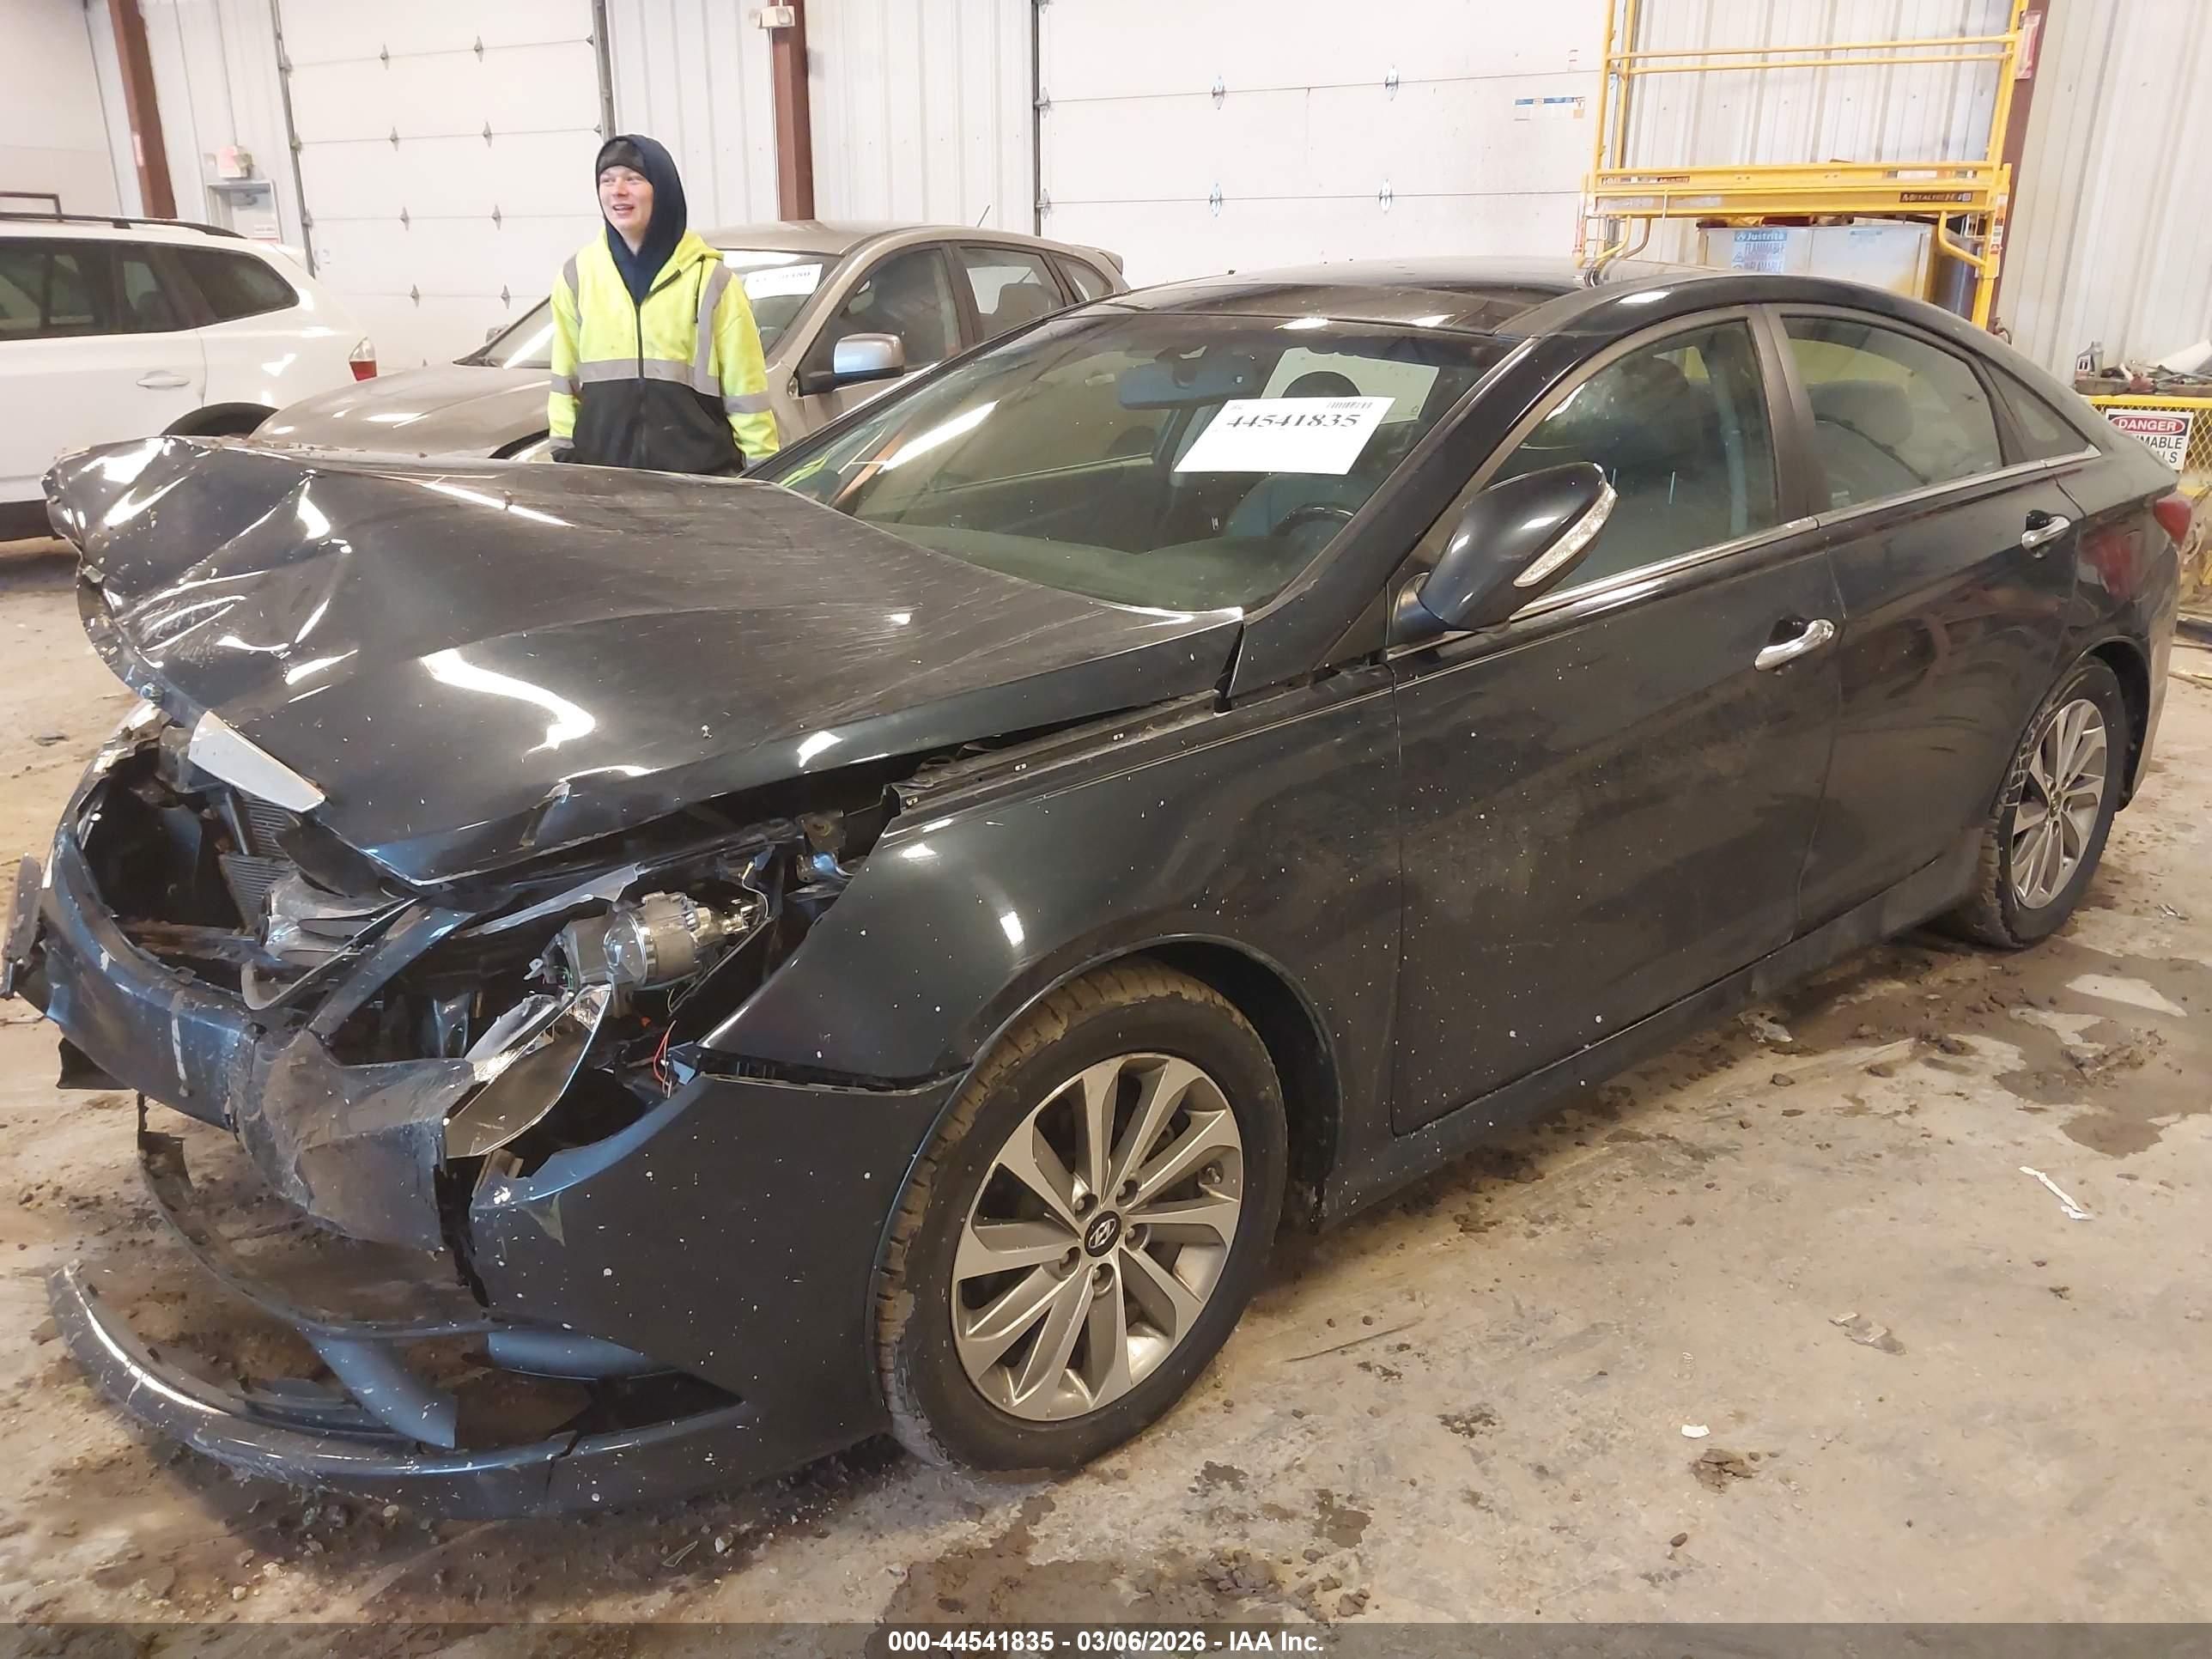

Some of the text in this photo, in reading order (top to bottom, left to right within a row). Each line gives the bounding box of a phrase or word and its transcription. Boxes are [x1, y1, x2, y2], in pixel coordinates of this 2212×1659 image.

[1746, 231, 1785, 240] Justrite
[1226, 414, 1361, 428] 44541835
[2118, 418, 2178, 432] DANGER
